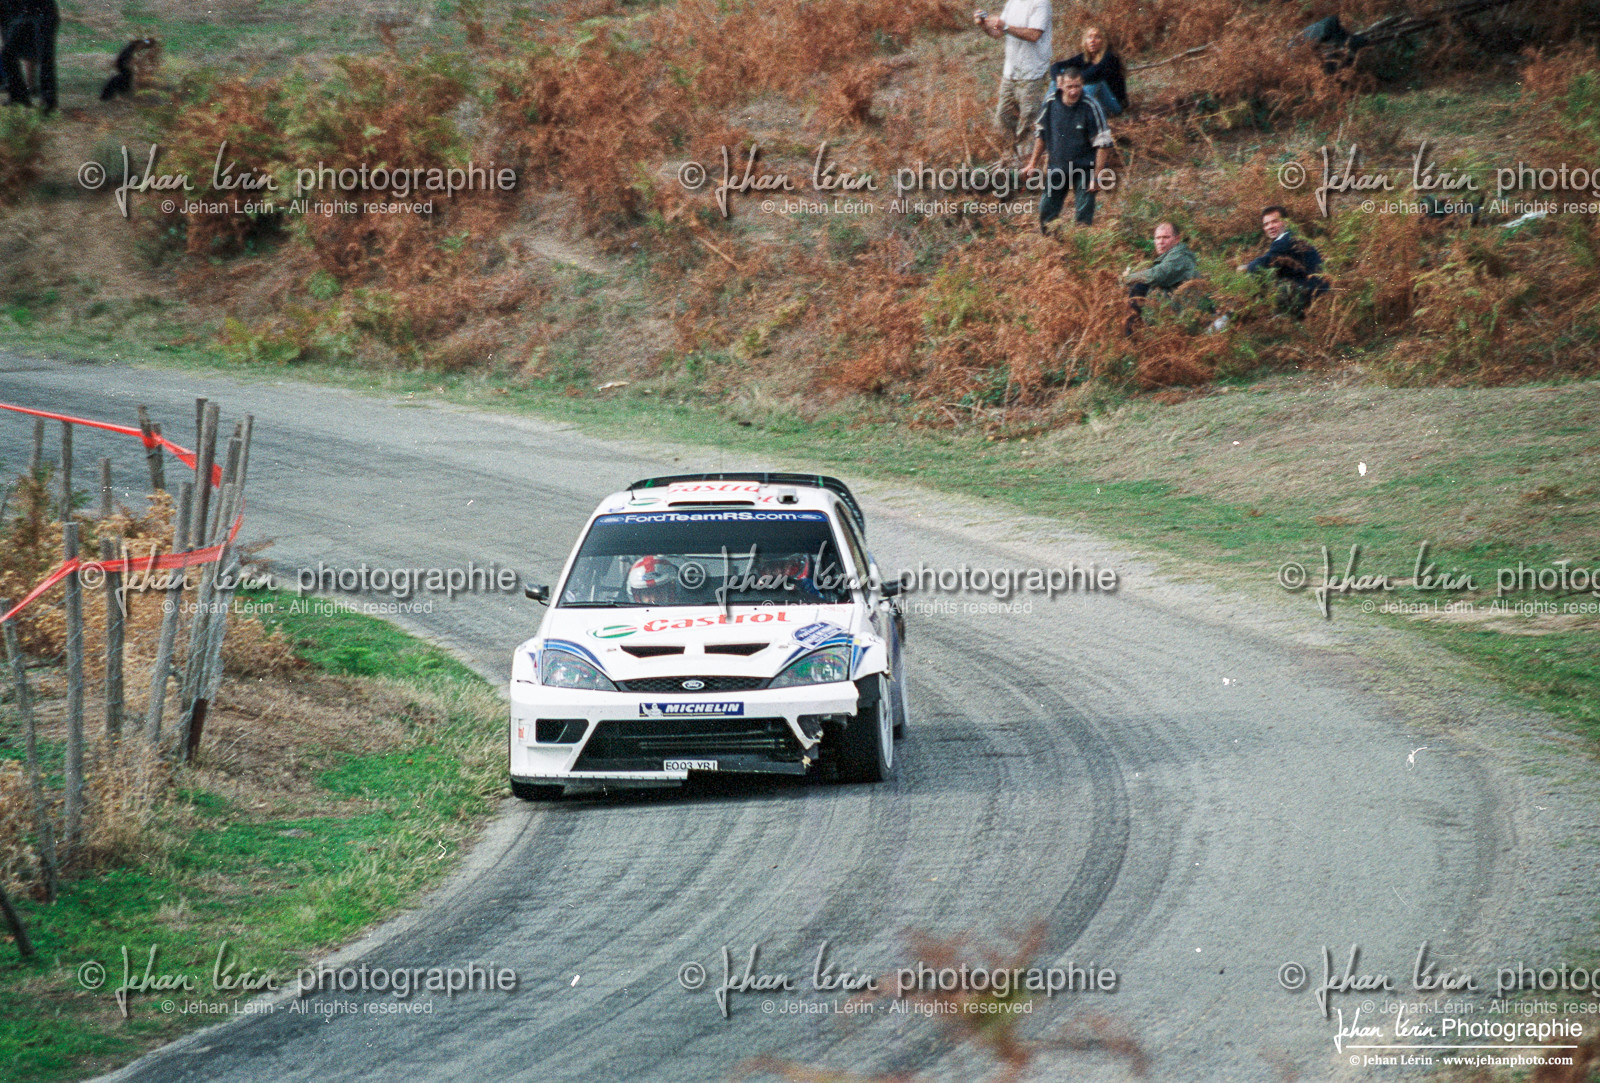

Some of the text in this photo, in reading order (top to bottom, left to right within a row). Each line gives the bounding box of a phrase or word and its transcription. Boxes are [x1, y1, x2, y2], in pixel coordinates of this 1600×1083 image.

[625, 511, 798, 524] FordTeamRS.com
[643, 611, 792, 632] Castrol
[665, 703, 740, 713] MICHELIN
